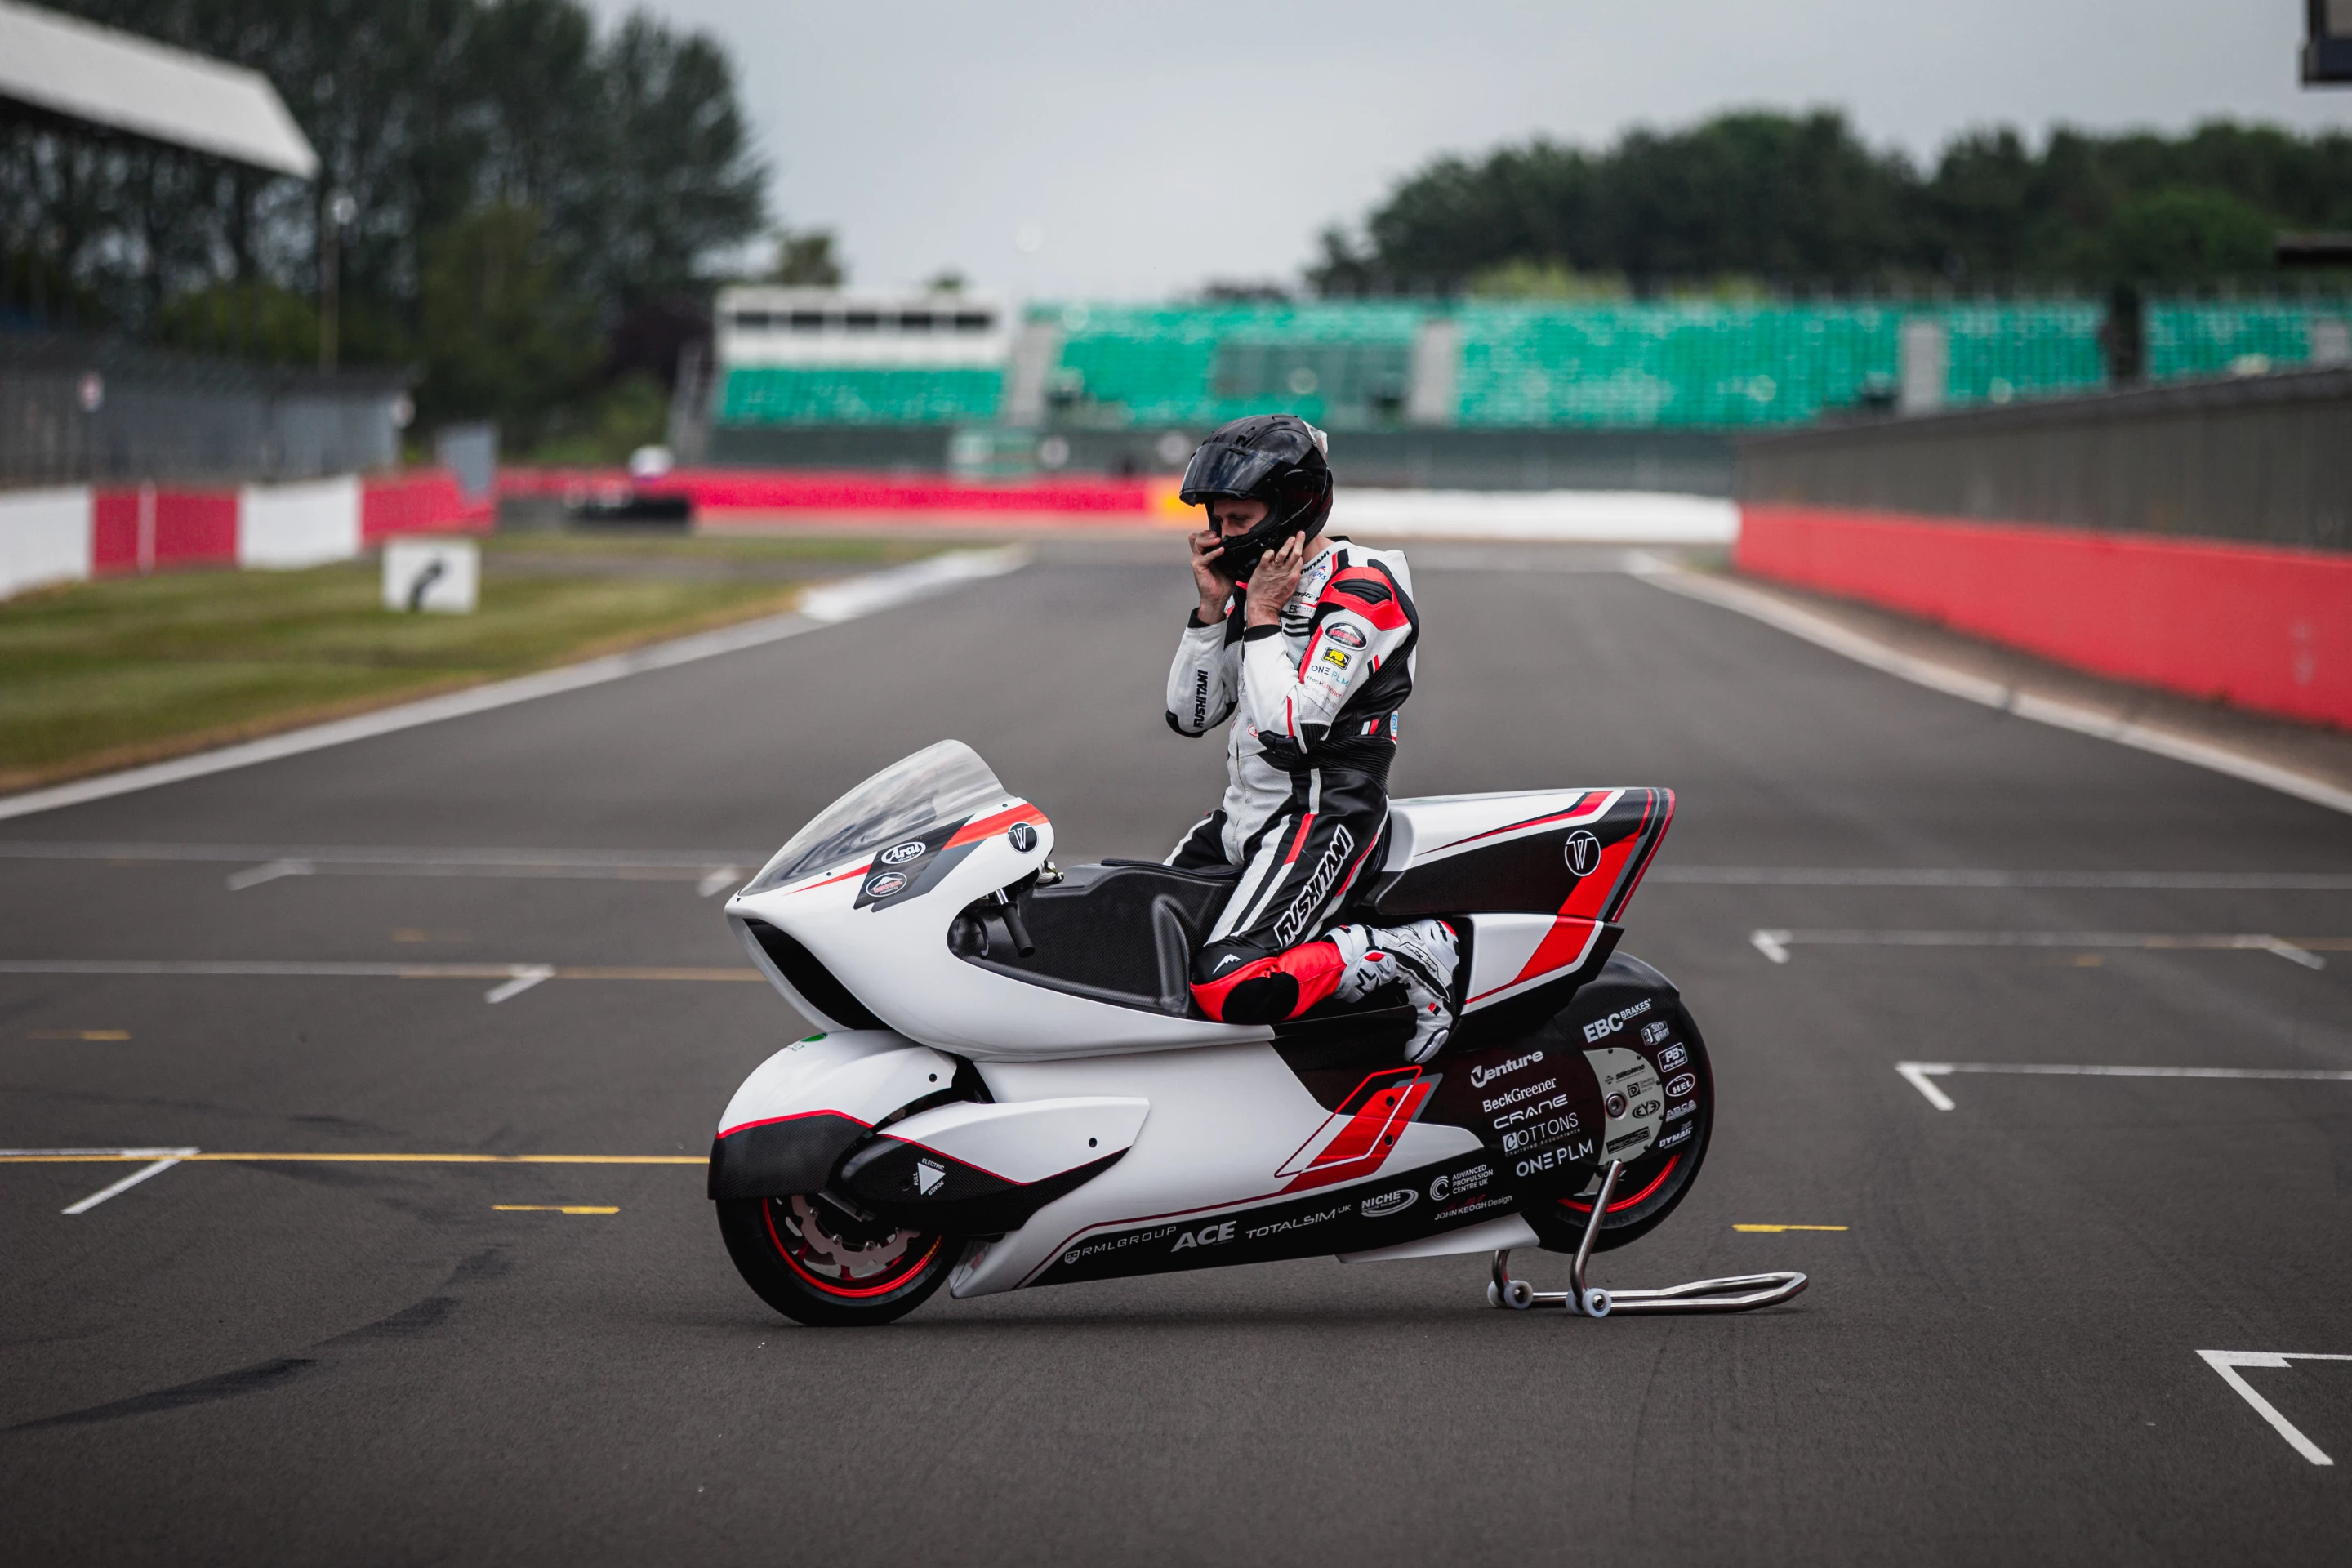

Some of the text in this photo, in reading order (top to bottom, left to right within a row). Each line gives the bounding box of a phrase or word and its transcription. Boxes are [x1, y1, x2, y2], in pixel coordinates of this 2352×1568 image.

[1311, 665, 1349, 687] ONE PLM
[886, 844, 922, 862] Arai
[1583, 1013, 1624, 1044] EBC
[1665, 1047, 1680, 1063] PB
[1471, 1050, 1544, 1089] Venture
[1482, 1077, 1557, 1113] BeckGreener
[1672, 1080, 1692, 1094] HEL
[1494, 1094, 1568, 1129] CRANE
[1503, 1112, 1579, 1152] COTTONS
[1504, 1128, 1581, 1157] Chartered Accountants
[1659, 1128, 1693, 1147] DYMAG
[922, 1158, 945, 1170] ELECTRIC
[1516, 1138, 1593, 1177] ONE PLM
[1452, 1165, 1487, 1181] ADVANCED
[1453, 1169, 1494, 1187] PROPULSION
[928, 1181, 944, 1196] POWER
[1453, 1182, 1477, 1194] CENTRE
[1361, 1190, 1401, 1209] NICHE
[1435, 1209, 1458, 1221] JOHN
[1458, 1201, 1487, 1214] KEOGH
[1487, 1195, 1512, 1207] Design
[1246, 1205, 1352, 1239] TOTALSIM UK
[1170, 1221, 1237, 1253] ACE
